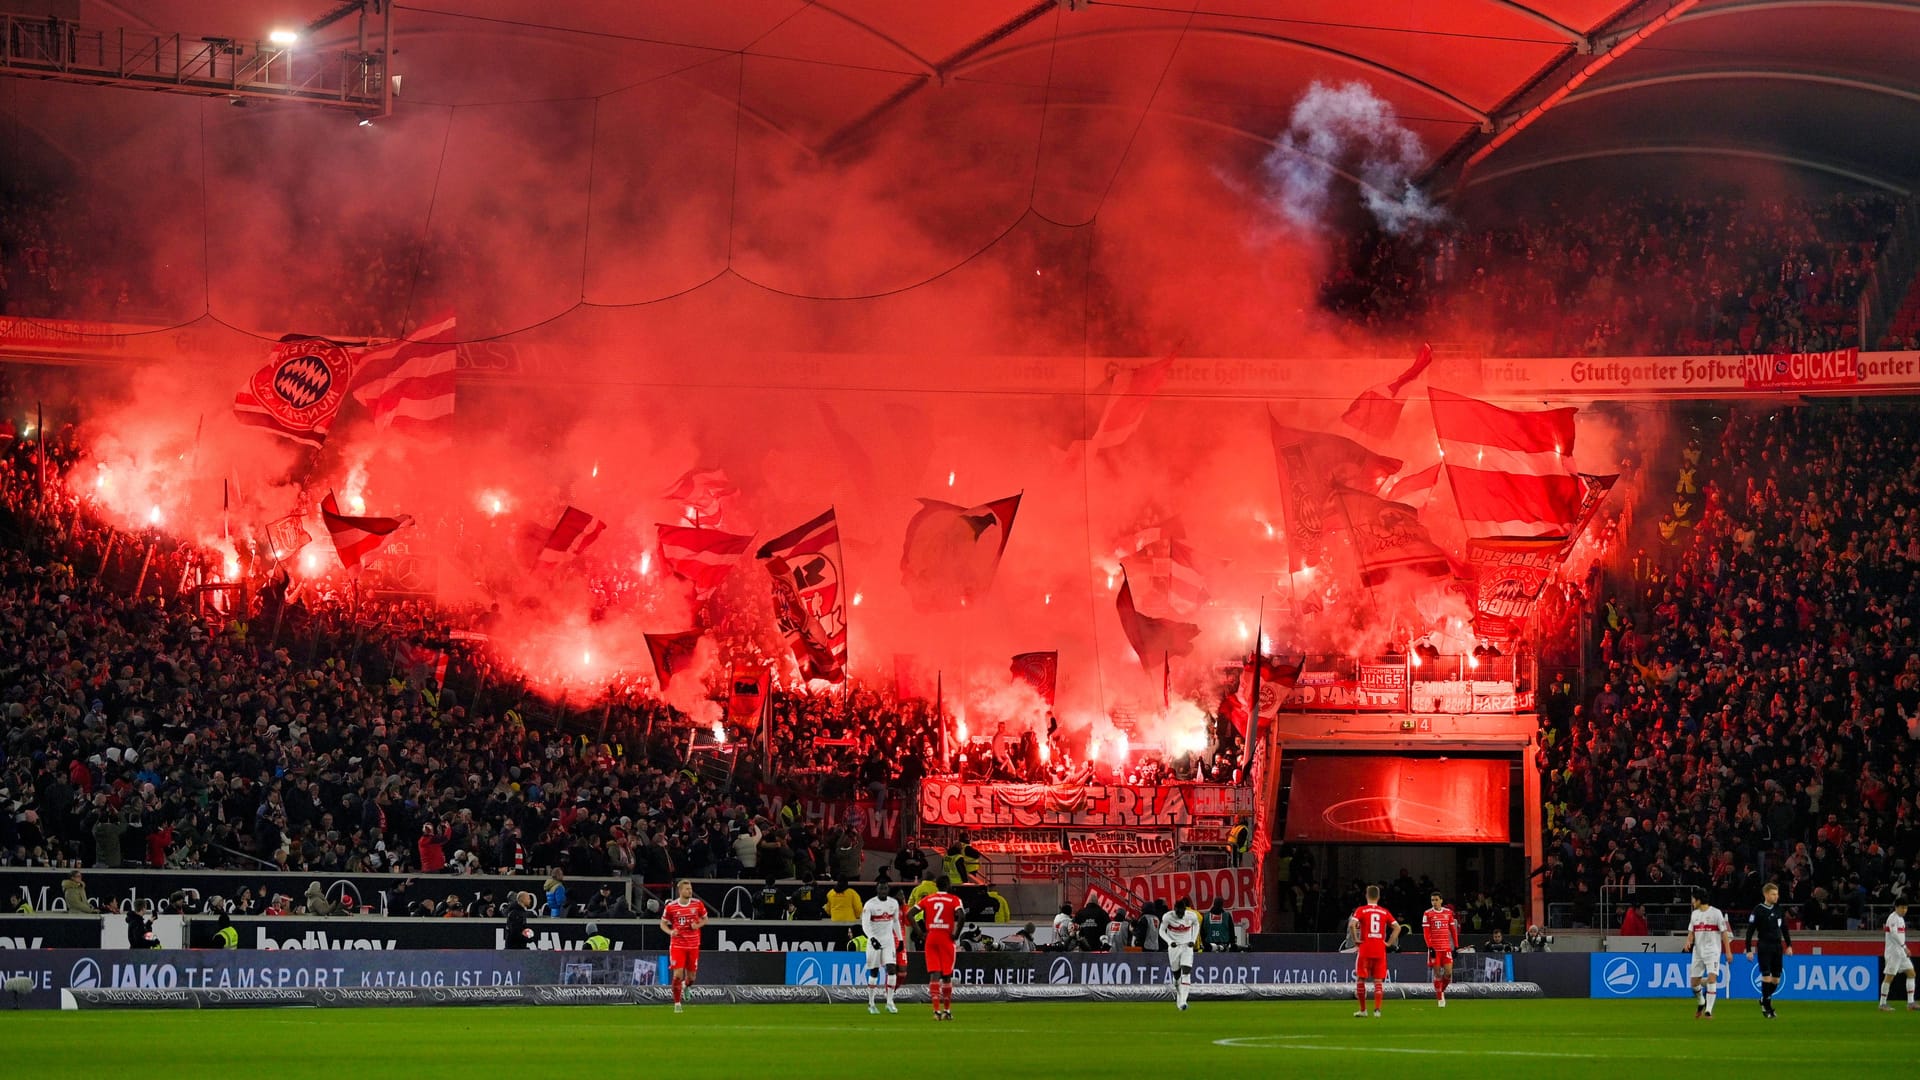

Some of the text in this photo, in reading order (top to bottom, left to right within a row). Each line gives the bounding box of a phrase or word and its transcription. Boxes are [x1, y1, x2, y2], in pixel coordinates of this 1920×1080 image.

[1571, 359, 1746, 386] Stuttgarter Hofbrä
[1745, 349, 1856, 382] RW GICKEL
[1857, 357, 1915, 382] garter
[1361, 674, 1405, 685] JUNGS!
[1420, 718, 1429, 731] 4
[1030, 842, 1058, 854] UNS
[933, 902, 945, 924] 2
[1370, 913, 1381, 934] 6
[1641, 942, 1657, 952] 71
[110, 964, 521, 989] JAKO TEAMSPORT KATALOG IST DA!
[994, 968, 1036, 985] NEUE
[1081, 962, 1132, 985] JAKO
[1138, 966, 1260, 985] TEASPORT
[1273, 969, 1337, 984] KATALOG
[1794, 964, 1870, 991] JAKO
